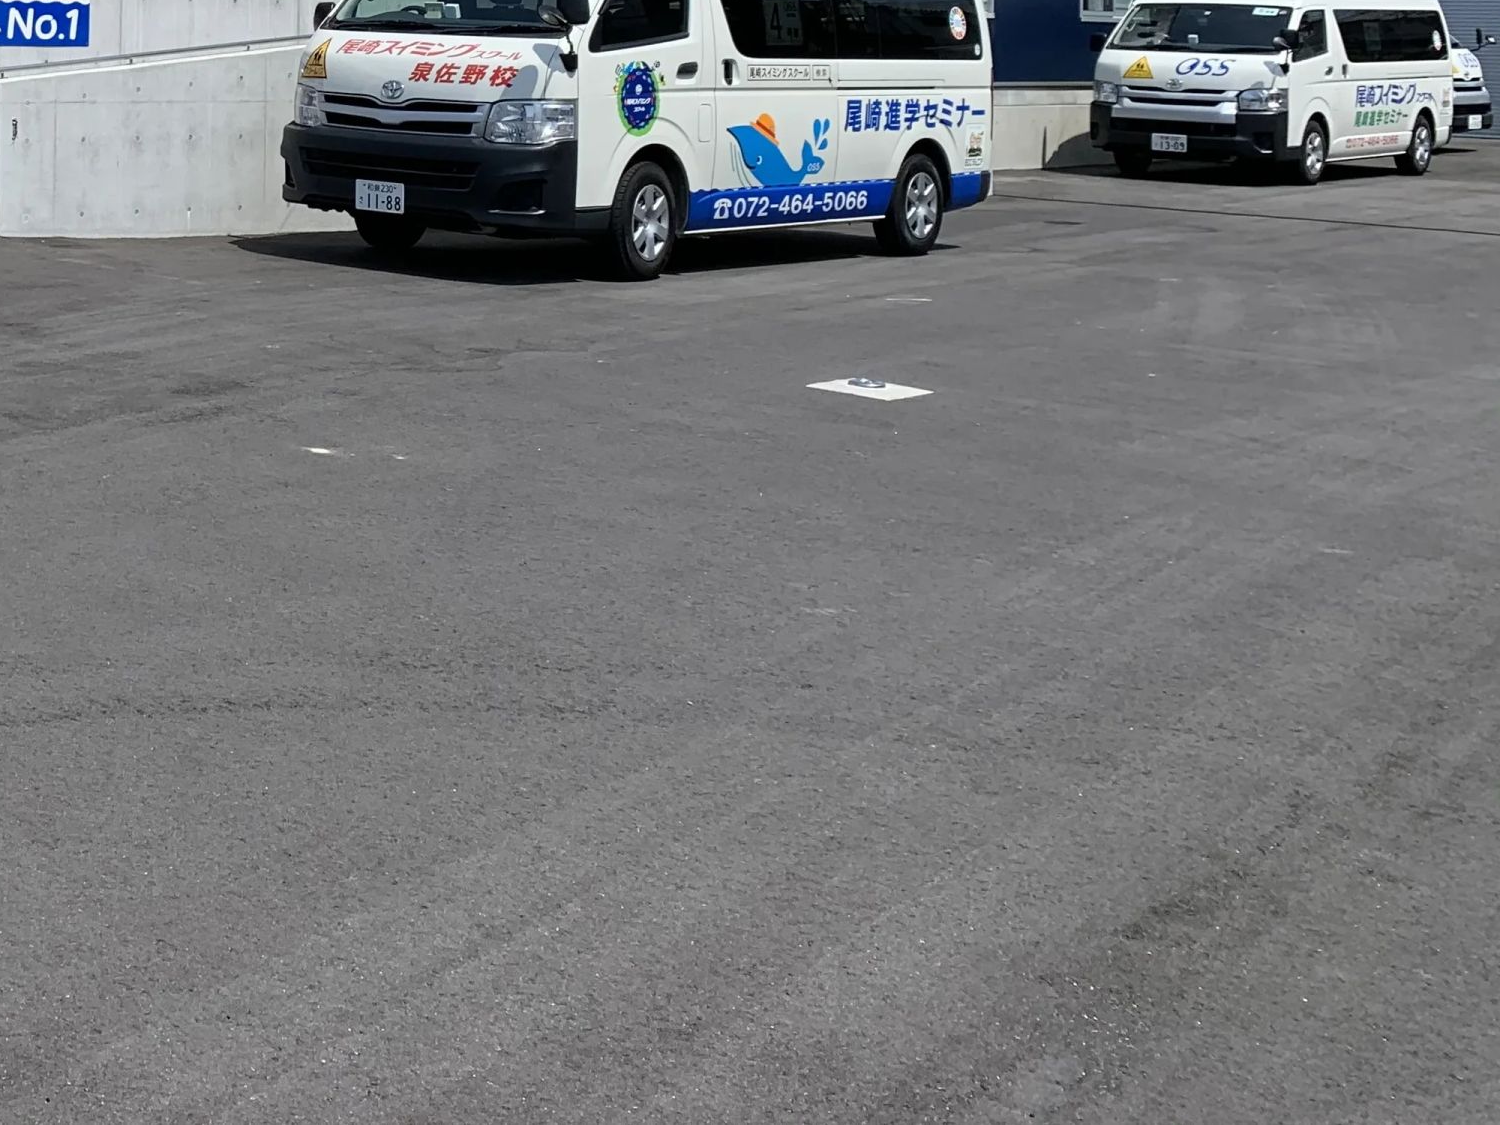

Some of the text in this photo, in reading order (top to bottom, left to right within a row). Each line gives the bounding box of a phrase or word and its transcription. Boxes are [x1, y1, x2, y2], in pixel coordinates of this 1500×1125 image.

[335, 38, 523, 61] 尾崎スイミングスクール
[408, 62, 520, 88] 泉佐野校
[1176, 57, 1237, 76] OSS
[844, 97, 986, 133] 尾崎進学セミナー
[367, 193, 401, 211] 11-88
[733, 190, 868, 218] 072-464-5066
